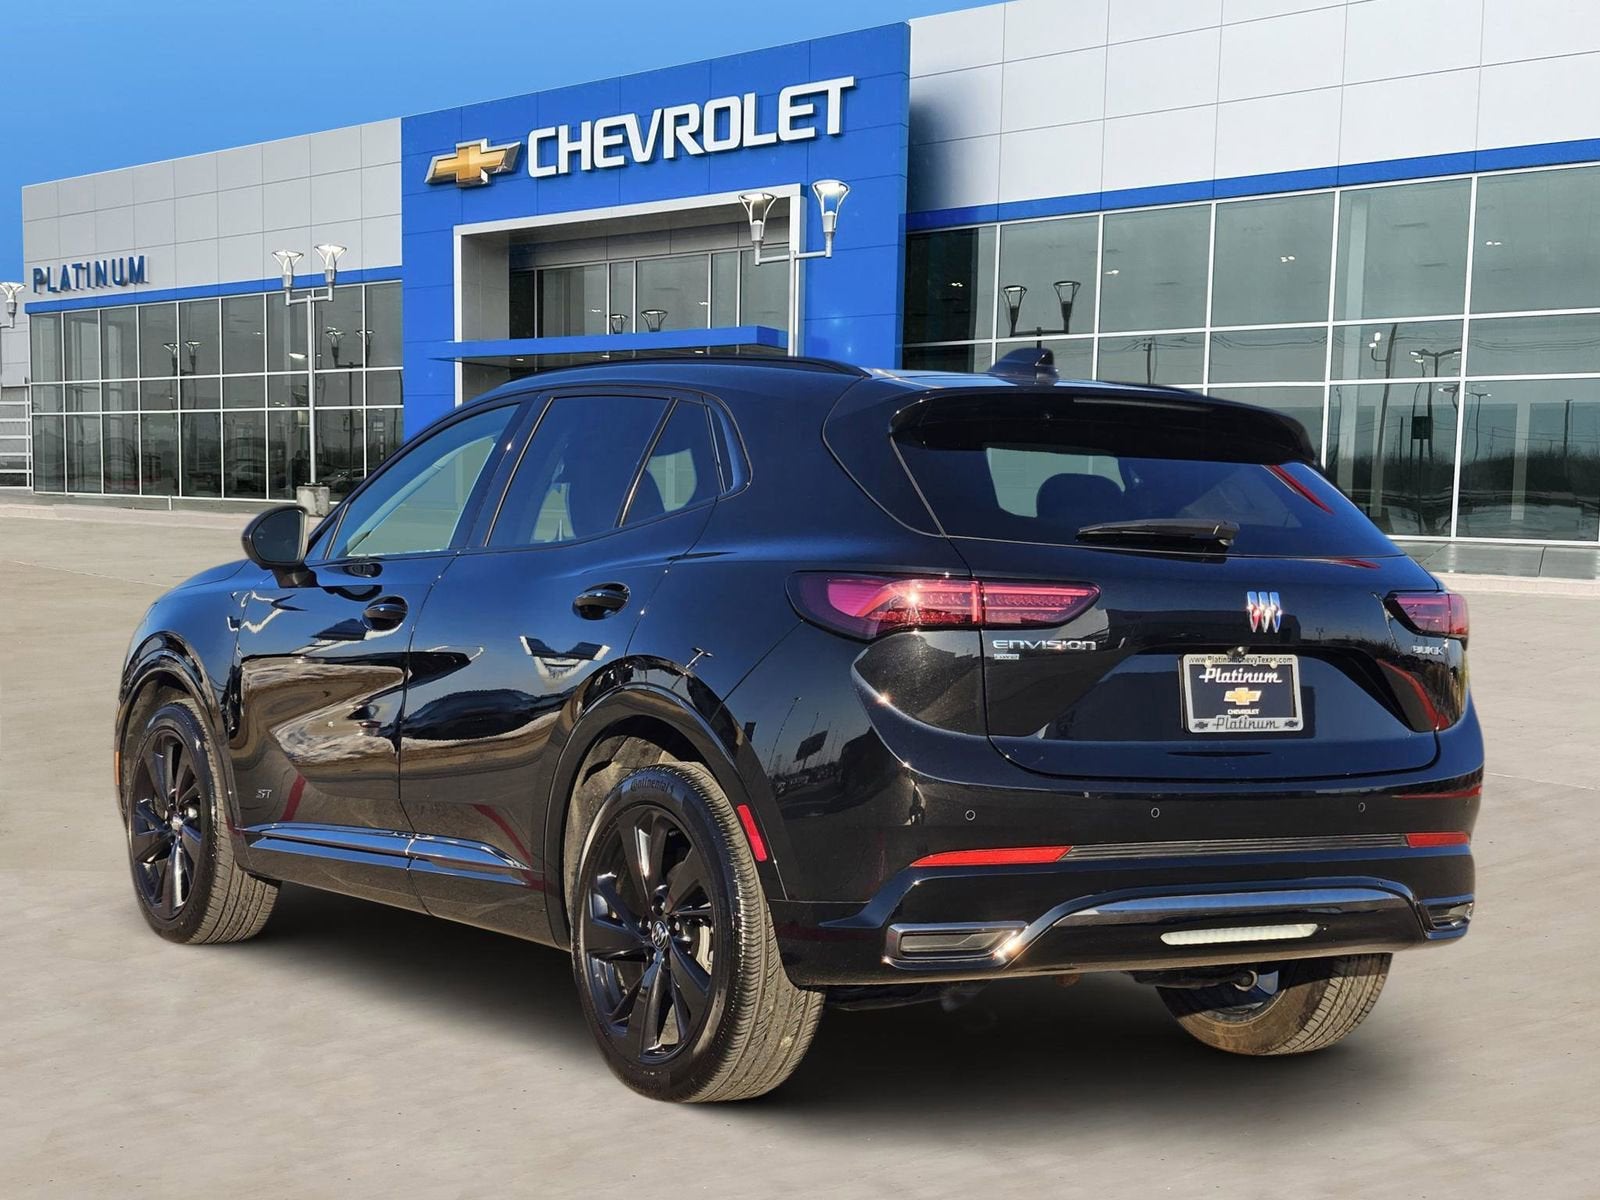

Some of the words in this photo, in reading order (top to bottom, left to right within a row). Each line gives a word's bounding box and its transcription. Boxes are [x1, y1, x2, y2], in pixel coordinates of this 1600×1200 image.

[527, 75, 856, 179] CHEVROLET
[32, 255, 145, 294] PLATINUM
[1198, 667, 1283, 683] Platinum
[1212, 715, 1280, 730] Platinum
[255, 789, 273, 799] ST
